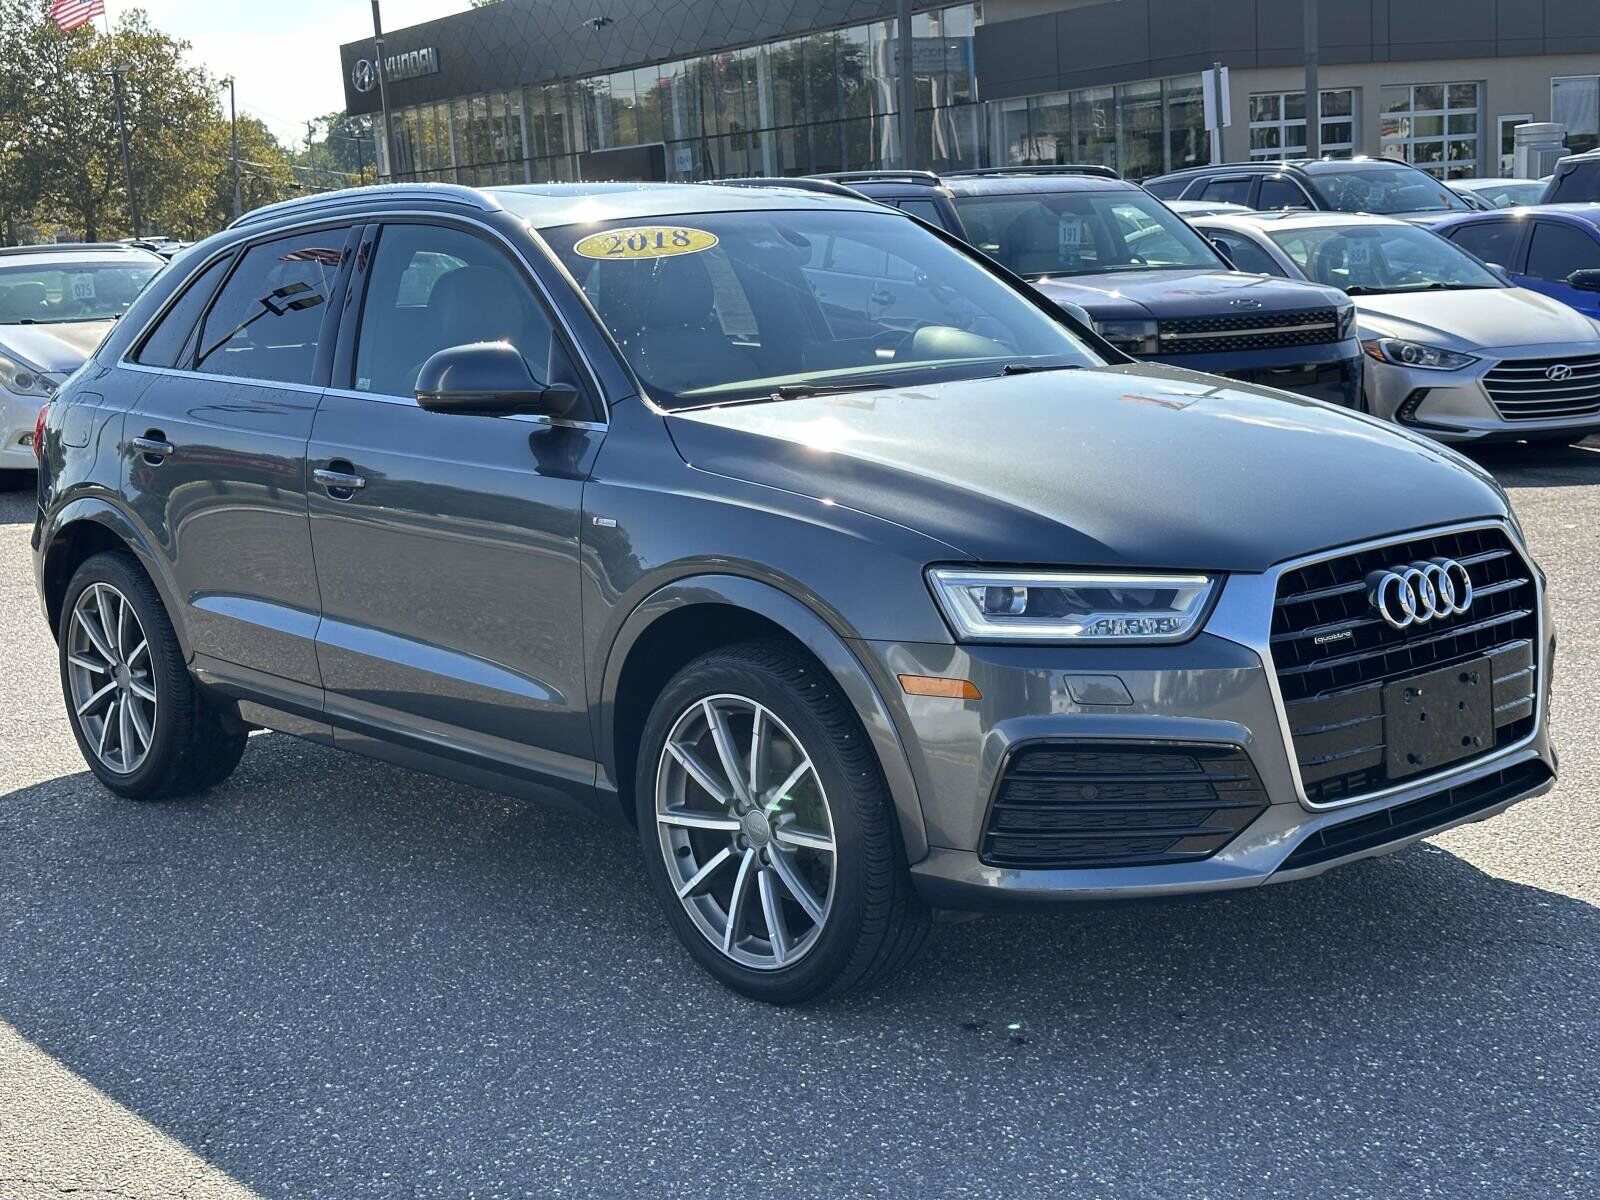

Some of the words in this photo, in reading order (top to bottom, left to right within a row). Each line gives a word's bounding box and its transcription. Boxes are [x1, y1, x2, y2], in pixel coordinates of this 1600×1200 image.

[606, 229, 690, 255] 2018
[1063, 227, 1077, 242] 191
[74, 282, 92, 297] 075
[1317, 631, 1351, 644] quattro
